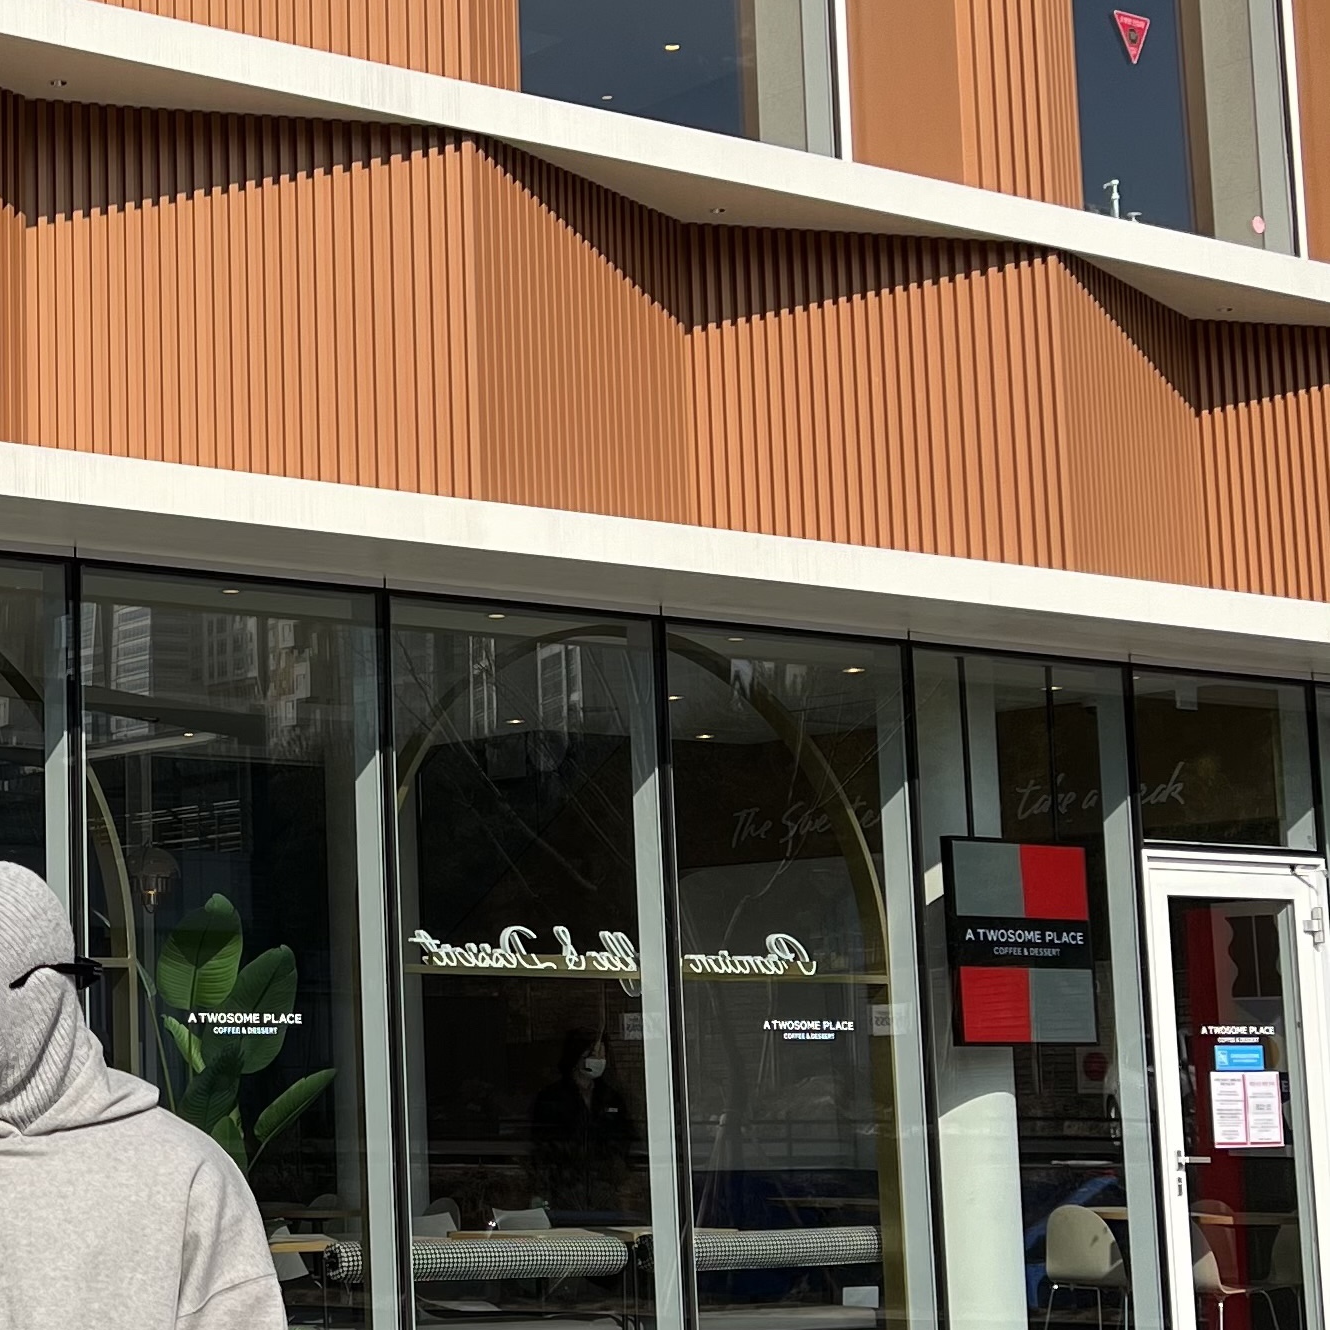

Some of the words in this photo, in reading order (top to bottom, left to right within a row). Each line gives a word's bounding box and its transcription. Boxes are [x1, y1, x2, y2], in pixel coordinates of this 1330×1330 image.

[732, 806, 774, 849] The
[965, 928, 975, 941] A
[977, 929, 1042, 943] TWOSOME
[1045, 931, 1085, 945] PLACE
[993, 946, 1022, 956] COFFEE
[1023, 947, 1029, 956] &
[1029, 947, 1061, 957] DESSERT
[188, 1012, 197, 1024] A
[198, 1012, 261, 1024] TWOSOME
[263, 1013, 303, 1024] PLACE
[213, 1026, 241, 1035] COFFEE
[242, 1027, 247, 1035] &
[247, 1027, 278, 1035] DESSERT
[763, 1020, 771, 1030] A
[771, 1020, 821, 1031] TWOSOME
[823, 1021, 855, 1031] PLACE
[1201, 1025, 1208, 1035] A
[1208, 1025, 1248, 1035] TWOSOME
[1248, 1025, 1275, 1035] PLACE
